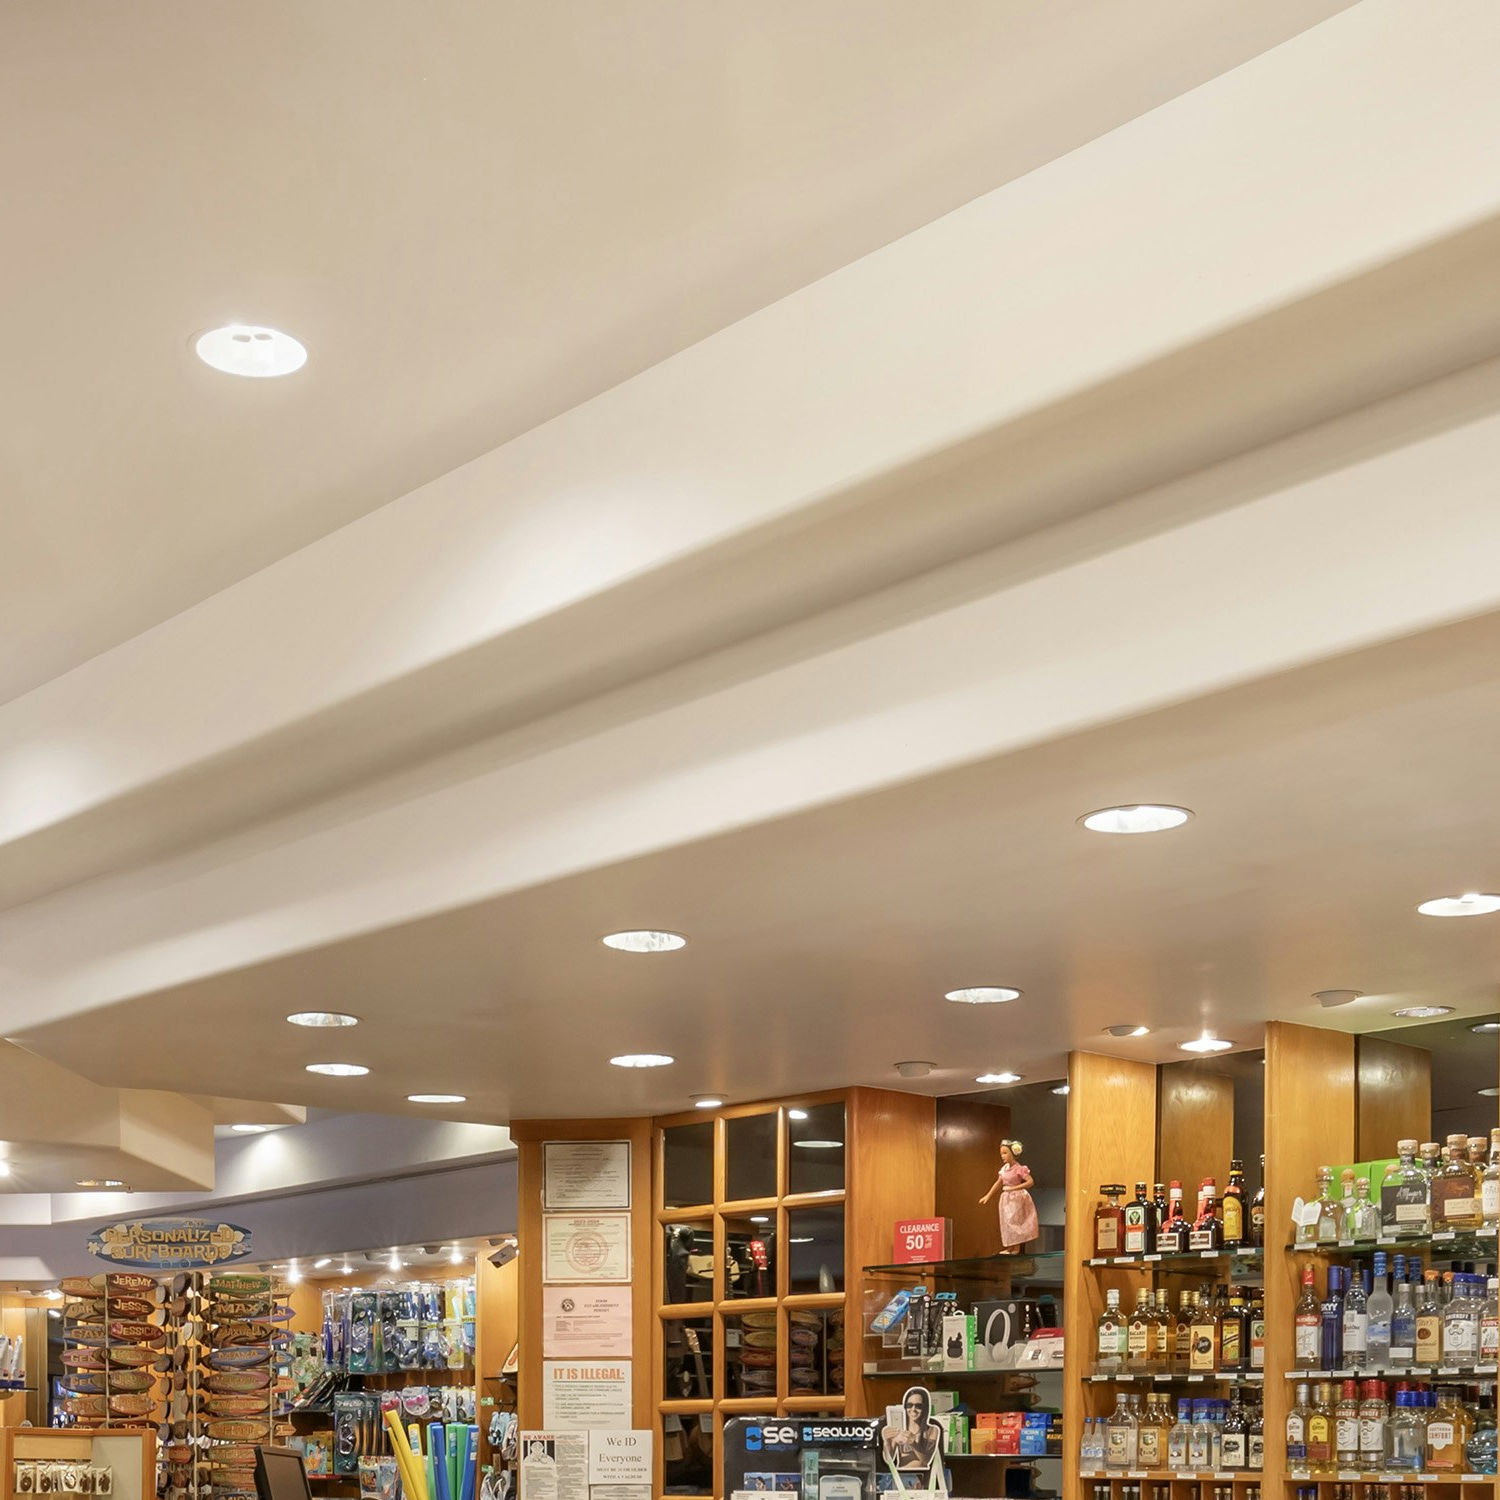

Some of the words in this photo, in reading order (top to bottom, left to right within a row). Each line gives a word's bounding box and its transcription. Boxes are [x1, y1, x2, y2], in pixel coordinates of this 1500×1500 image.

[900, 1223, 939, 1233] CLEARANCE
[105, 1228, 235, 1244] PERSONALIZED
[906, 1235, 924, 1250] 50
[111, 1245, 230, 1261] SURFBOARDS
[113, 1275, 152, 1287] JEREMY
[216, 1279, 261, 1290] MATTHEW
[116, 1300, 149, 1313] JESSE
[218, 1302, 260, 1313] MAX
[553, 1368, 564, 1379] IT
[567, 1368, 578, 1379] IS
[581, 1368, 625, 1379] ILLEGAL:
[812, 1427, 875, 1441] seawag
[606, 1437, 622, 1446] We
[625, 1437, 637, 1446] ID
[599, 1454, 643, 1464] Everyone
